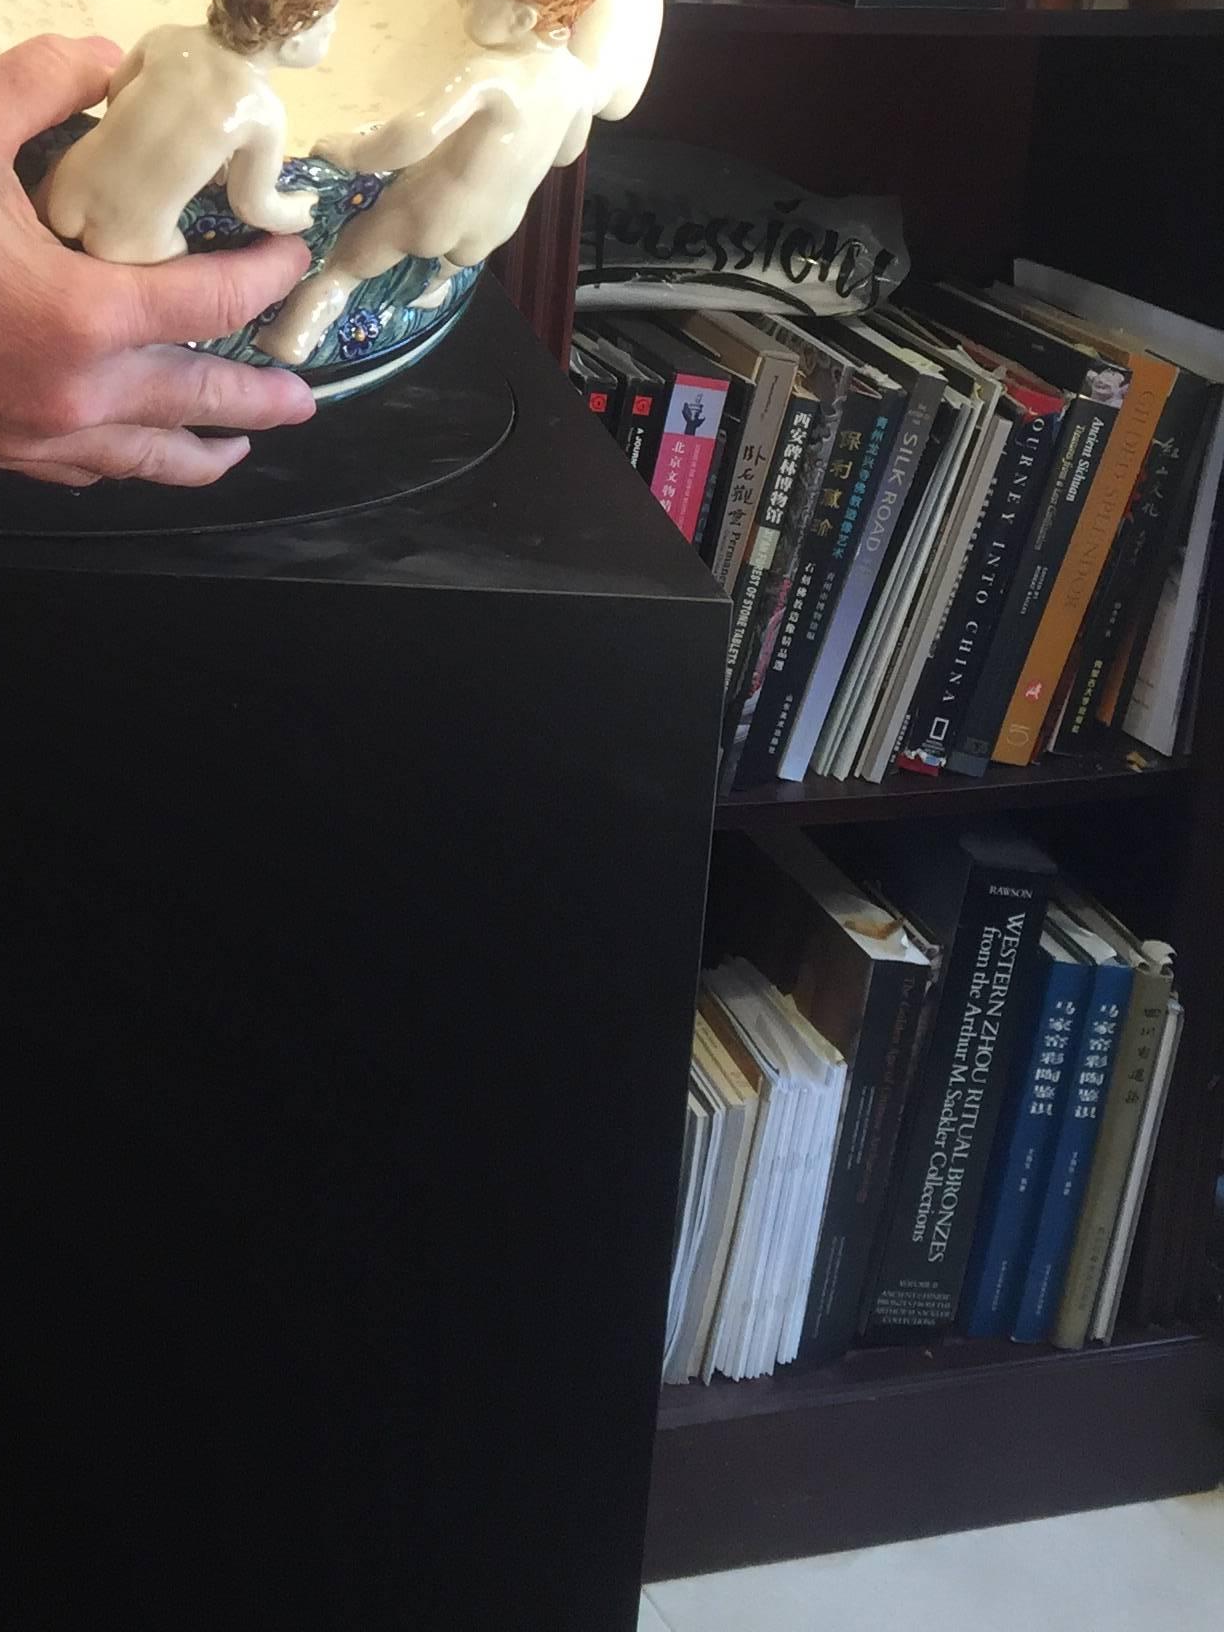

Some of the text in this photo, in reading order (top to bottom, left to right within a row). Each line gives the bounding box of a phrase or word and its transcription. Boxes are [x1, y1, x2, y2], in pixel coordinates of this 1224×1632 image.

[1057, 460, 1073, 480] from
[1065, 416, 1105, 502] Ancient Sichuan
[1114, 389, 1157, 481] GILDED
[865, 431, 918, 552] SILK ROAD
[976, 540, 1006, 604] INTO
[1066, 486, 1120, 610] SPLENDOR
[739, 598, 754, 627] STONE
[748, 586, 758, 599] OF
[727, 628, 745, 665] TABLETS
[942, 621, 979, 702] CHINA
[989, 885, 1033, 899] RAWSON
[912, 926, 1002, 1243] from the Arthur M. Sackler Collections
[927, 912, 1026, 1263] WESTERN ZHOU RITUAL BRONZES
